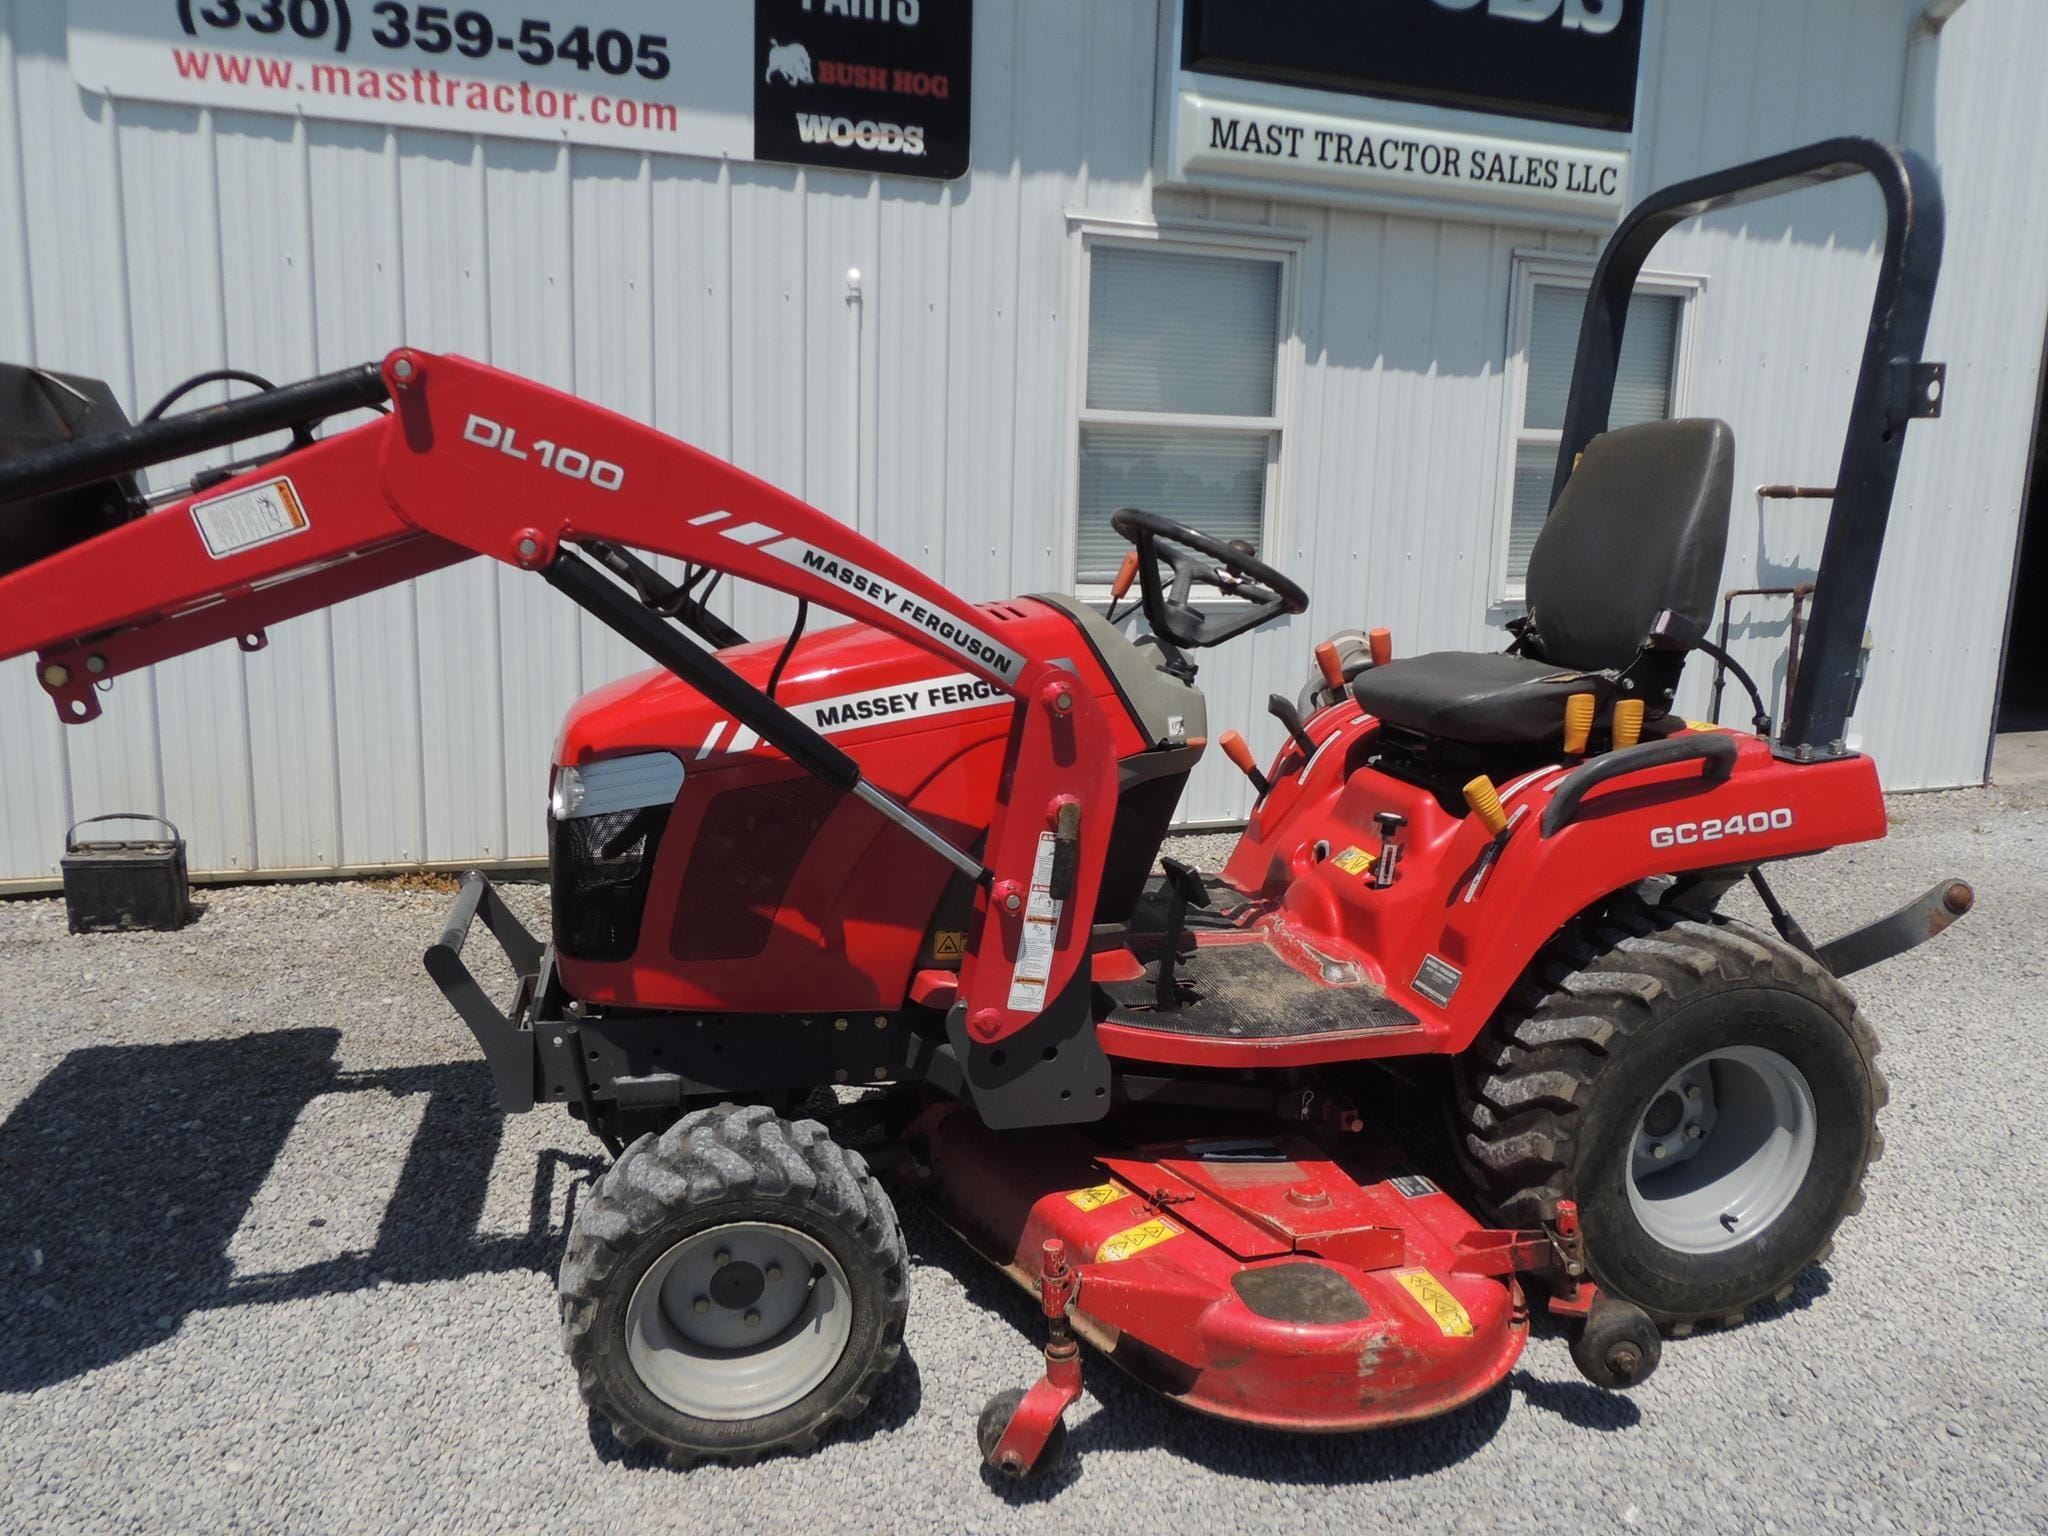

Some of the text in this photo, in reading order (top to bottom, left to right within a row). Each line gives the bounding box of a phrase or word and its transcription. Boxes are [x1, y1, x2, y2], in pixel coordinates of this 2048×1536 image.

[176, 0, 670, 80] (330) 359-5405
[172, 48, 677, 132] www.masttractor.com
[818, 61, 949, 98] BUSH HOG
[796, 112, 925, 156] WOODS
[1209, 117, 1618, 196] MAST TRACTOR SALES LLC
[463, 413, 624, 491] DL100
[802, 549, 1013, 674] MASSEY FERGUSON
[815, 692, 920, 727] MASSEY
[1650, 808, 1793, 848] GC2400
